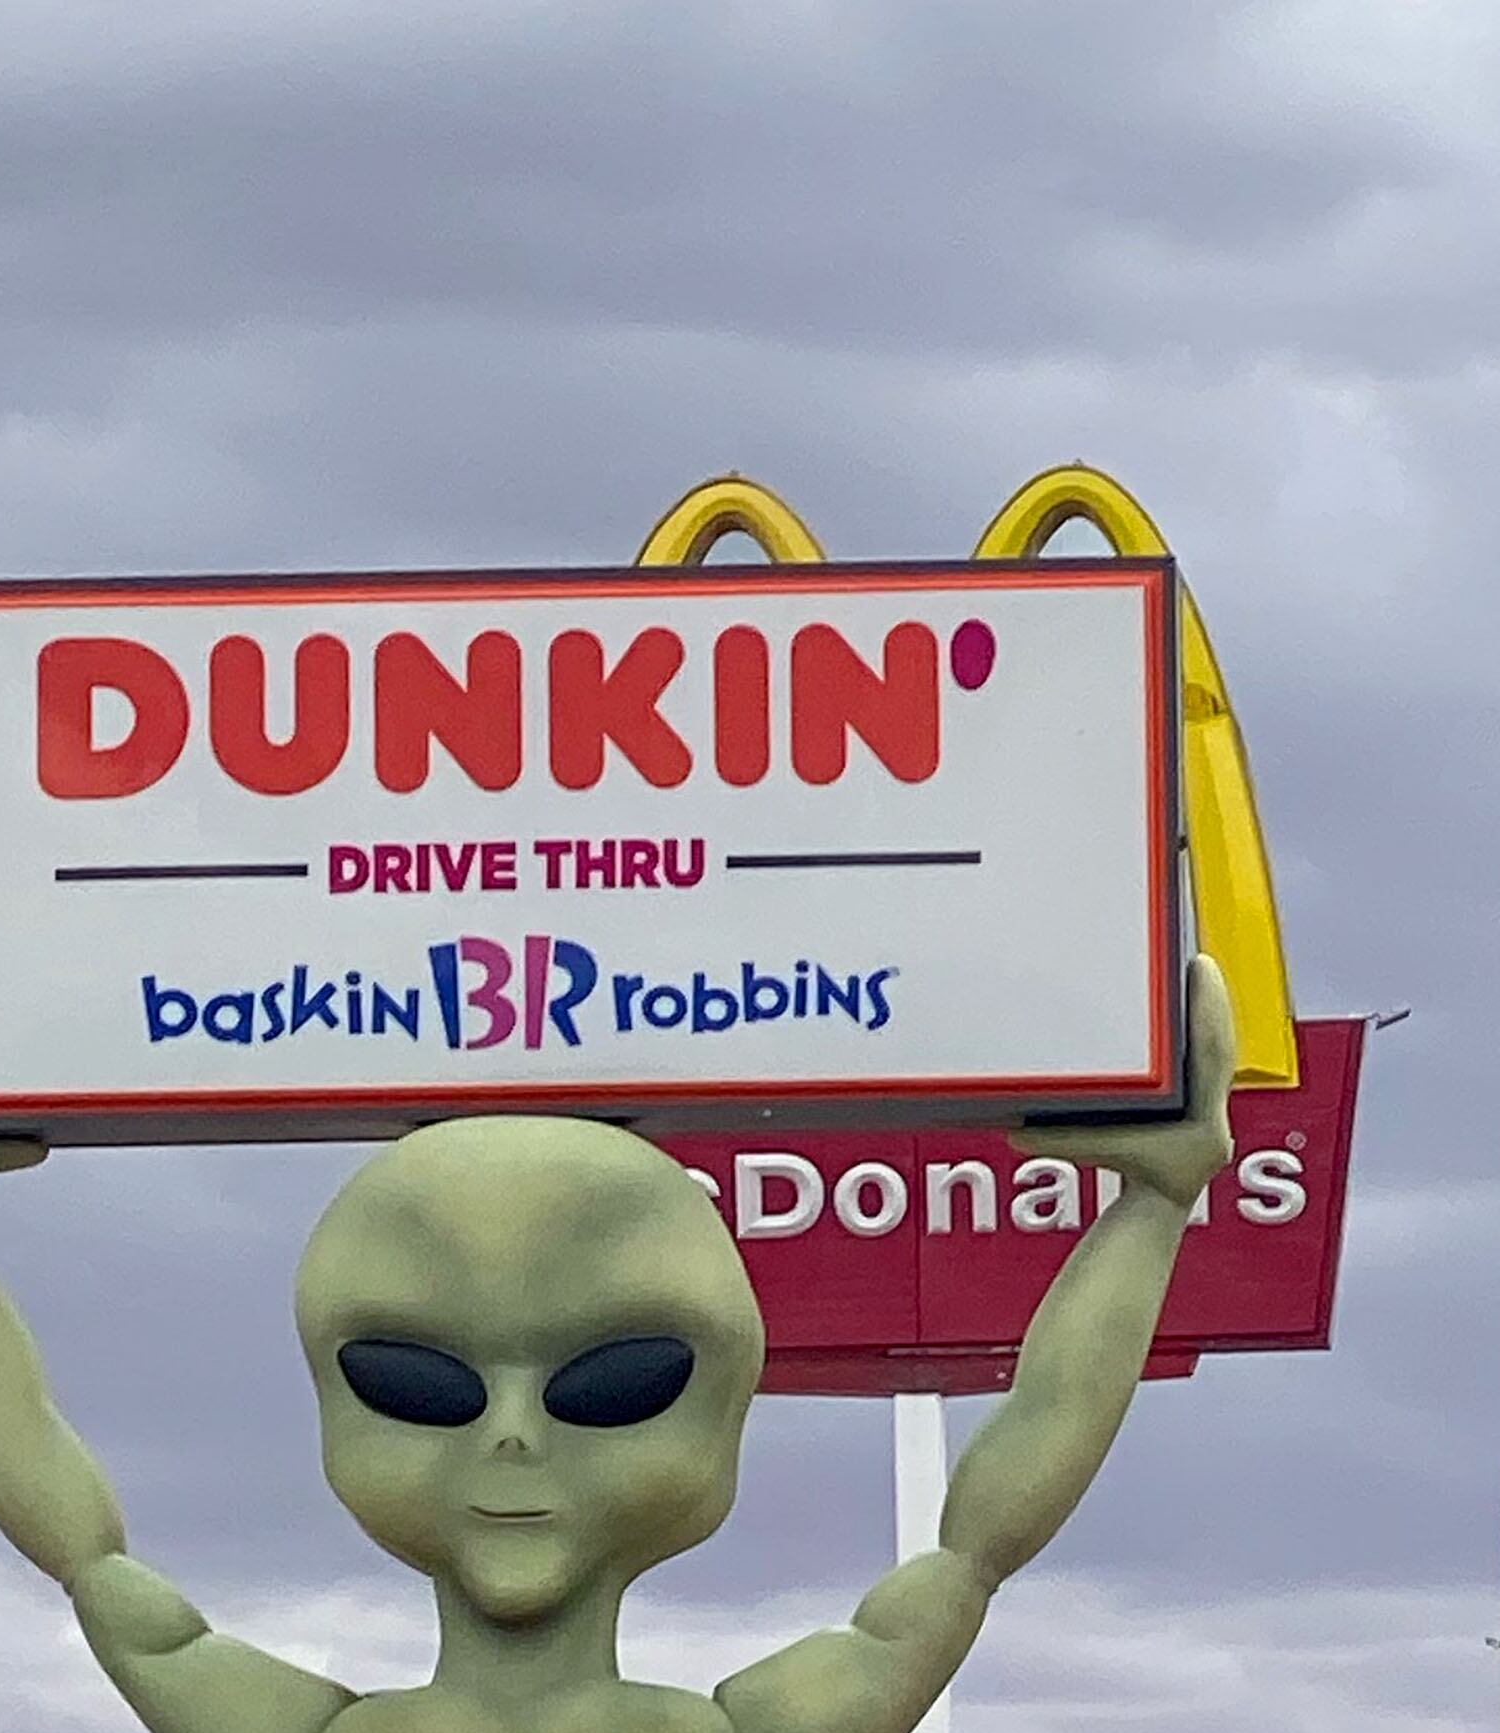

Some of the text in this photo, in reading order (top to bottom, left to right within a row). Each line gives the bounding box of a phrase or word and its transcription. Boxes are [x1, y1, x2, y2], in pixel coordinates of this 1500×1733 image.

[37, 618, 996, 801] DUNKIN'
[328, 837, 706, 894] DRIVE THRU
[141, 935, 902, 1051] baskin BR robbins
